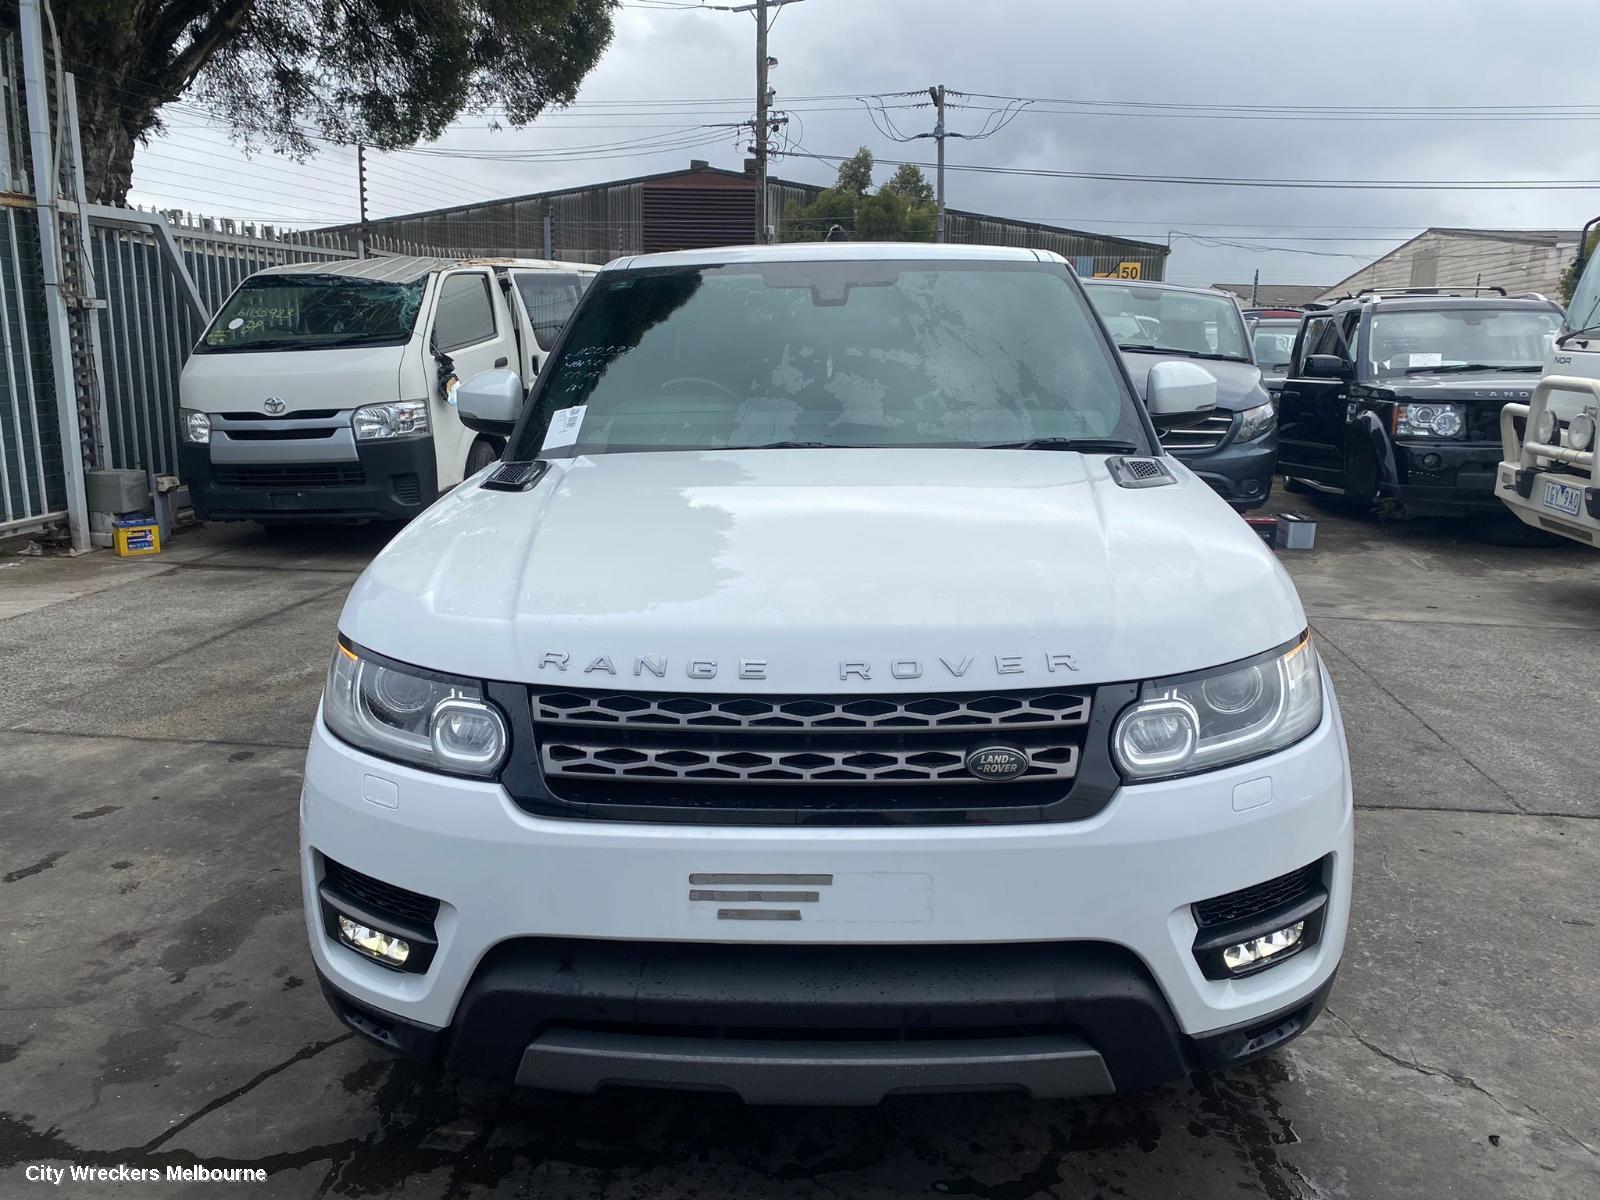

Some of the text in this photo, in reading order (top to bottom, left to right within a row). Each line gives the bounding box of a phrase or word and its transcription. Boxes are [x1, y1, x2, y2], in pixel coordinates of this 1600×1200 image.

[1121, 267, 1138, 280] 50
[538, 649, 1080, 681] RANGE ROVER
[980, 754, 1009, 764] LAND
[983, 763, 1018, 773] ROVER
